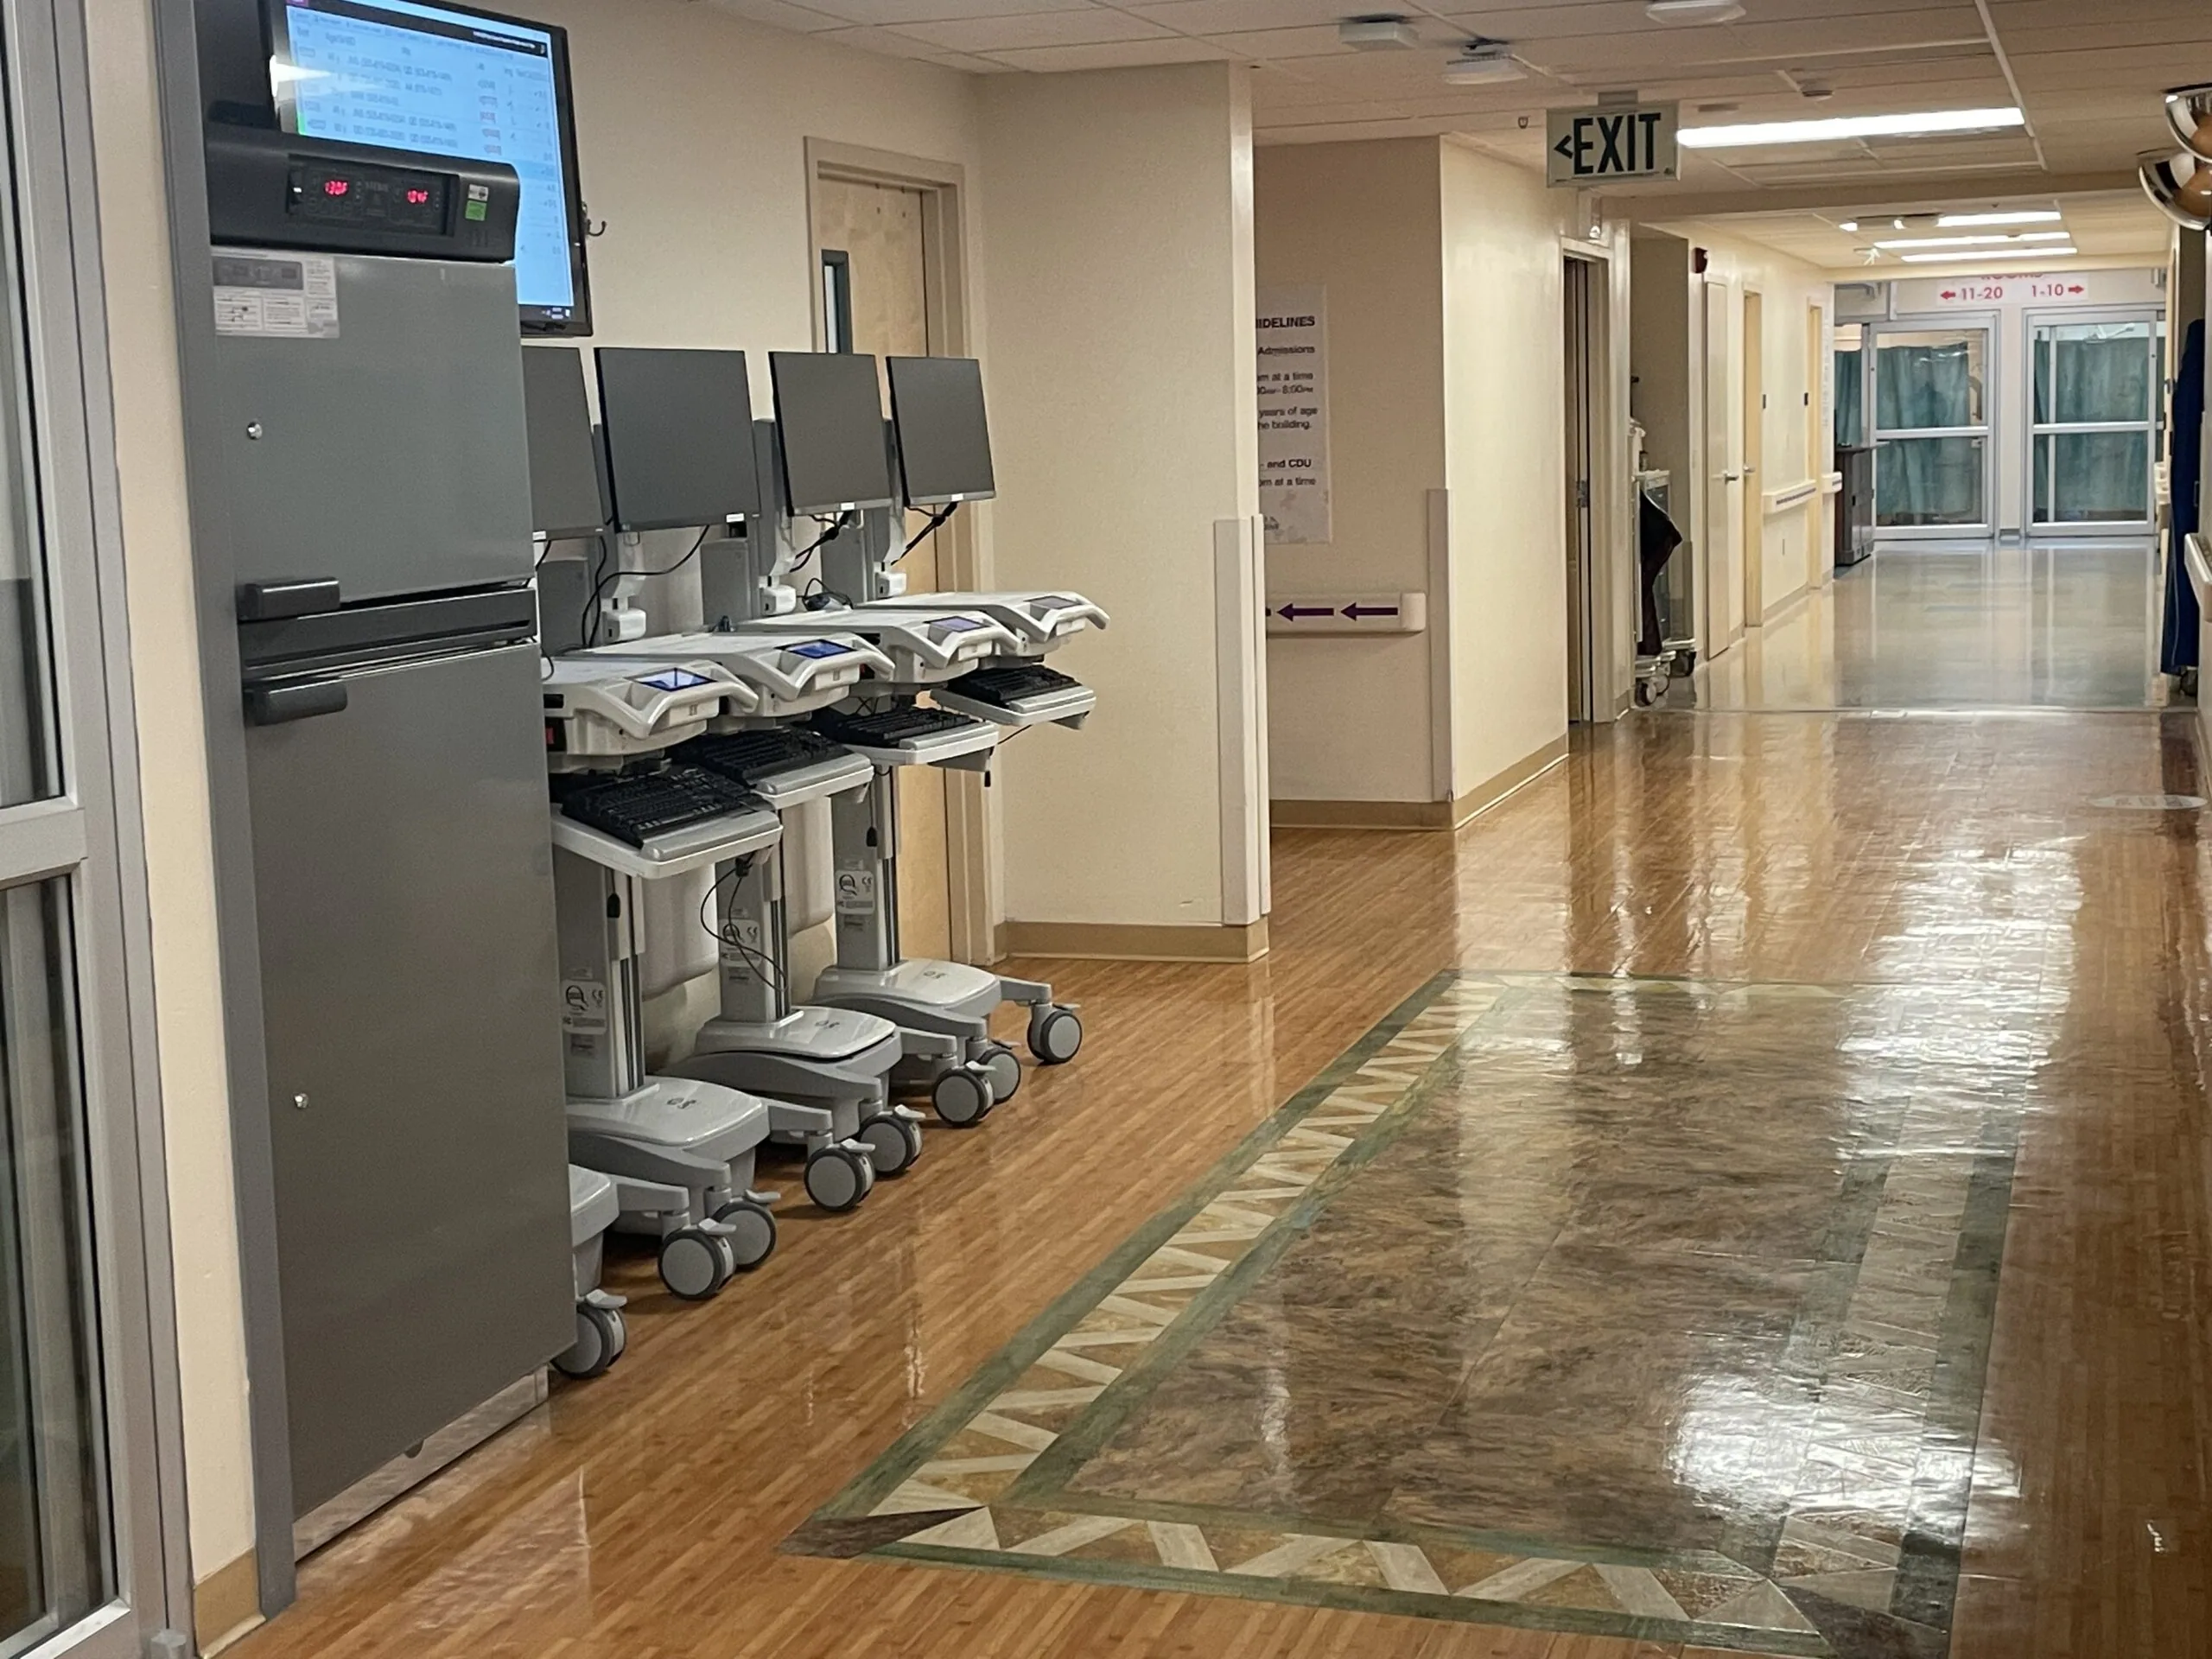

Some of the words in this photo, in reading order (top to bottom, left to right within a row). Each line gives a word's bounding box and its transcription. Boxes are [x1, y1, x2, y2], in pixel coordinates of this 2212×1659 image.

[1573, 112, 1661, 175] EXIT
[1961, 286, 2003, 301] 11-20
[2031, 283, 2064, 297] 1-10
[1271, 372, 1281, 381] at
[1293, 372, 1313, 380] time
[1287, 406, 1298, 416] of
[1300, 407, 1319, 416] age
[1267, 460, 1286, 468] and
[1288, 459, 1312, 468] CDU
[1274, 477, 1284, 486] at
[1295, 477, 1317, 486] time
